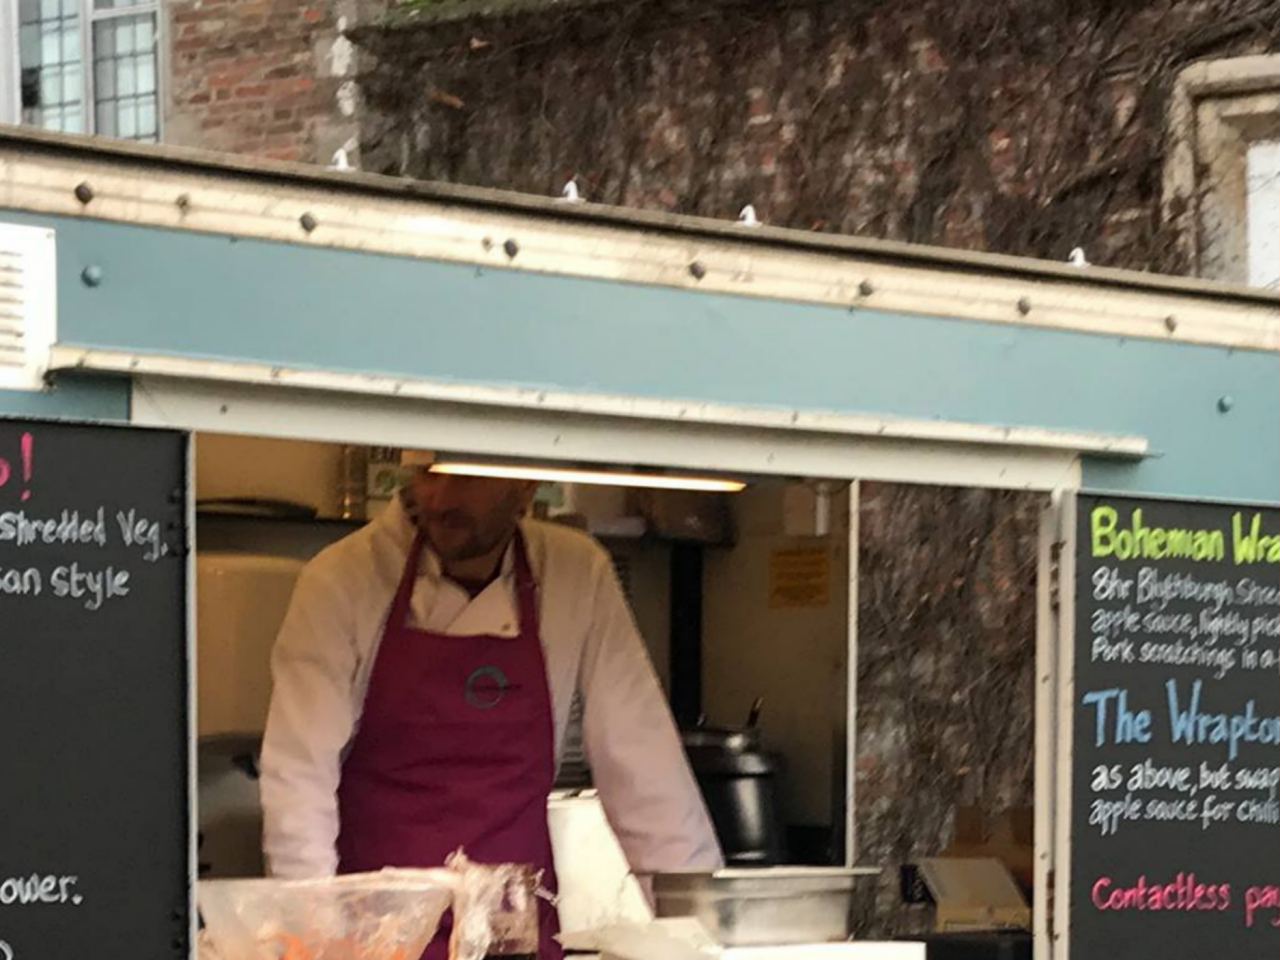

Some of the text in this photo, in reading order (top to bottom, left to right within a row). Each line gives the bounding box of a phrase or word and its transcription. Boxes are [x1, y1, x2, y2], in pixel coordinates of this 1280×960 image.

[1082, 685, 1152, 747] The
[1091, 764, 1123, 792] as
[1126, 758, 1197, 797] above,
[1199, 760, 1232, 790] but
[1089, 792, 1142, 836] apple
[1143, 799, 1199, 821] sauce
[1200, 795, 1236, 831] for
[1091, 871, 1231, 911] Contactless
